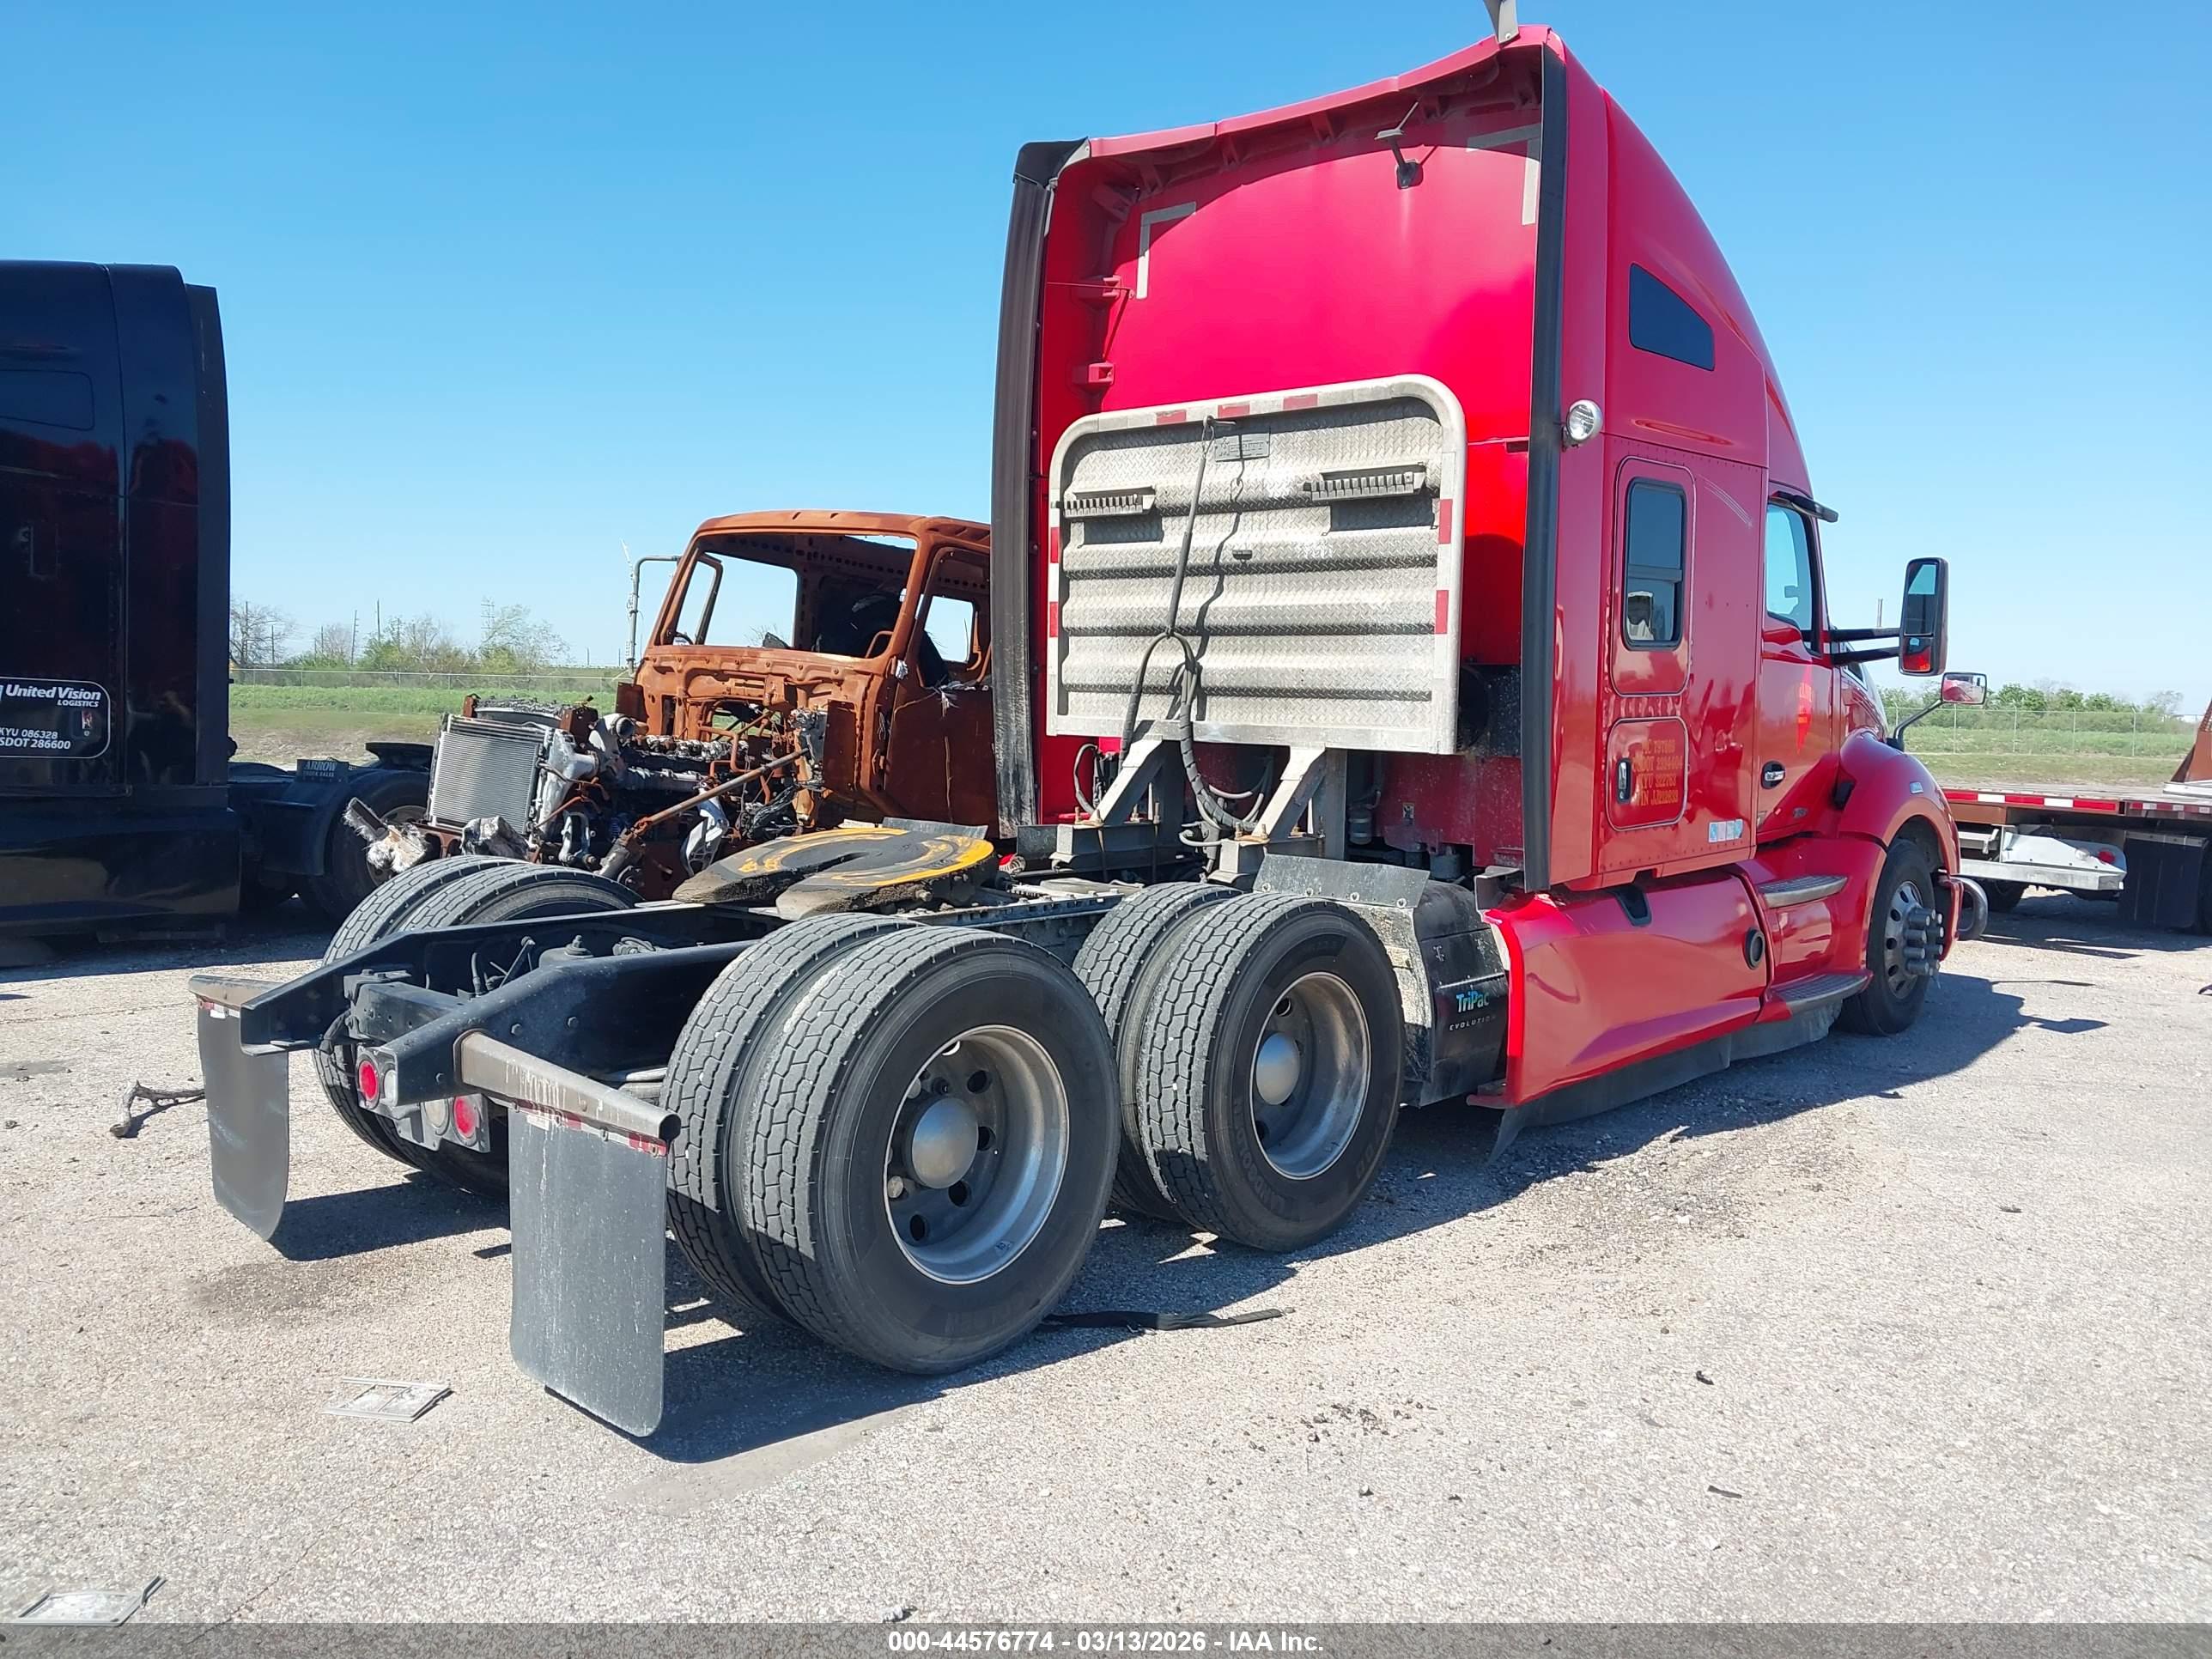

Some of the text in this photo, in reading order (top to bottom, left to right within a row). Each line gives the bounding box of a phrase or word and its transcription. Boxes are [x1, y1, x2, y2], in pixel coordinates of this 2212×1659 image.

[5, 684, 101, 701] United Vision
[57, 699, 100, 708] LOGISTICS
[21, 729, 58, 739] 086328
[30, 738, 71, 750] 286600
[304, 762, 337, 771] ARROW
[1449, 1015, 1496, 1031] EVOLUTIO
